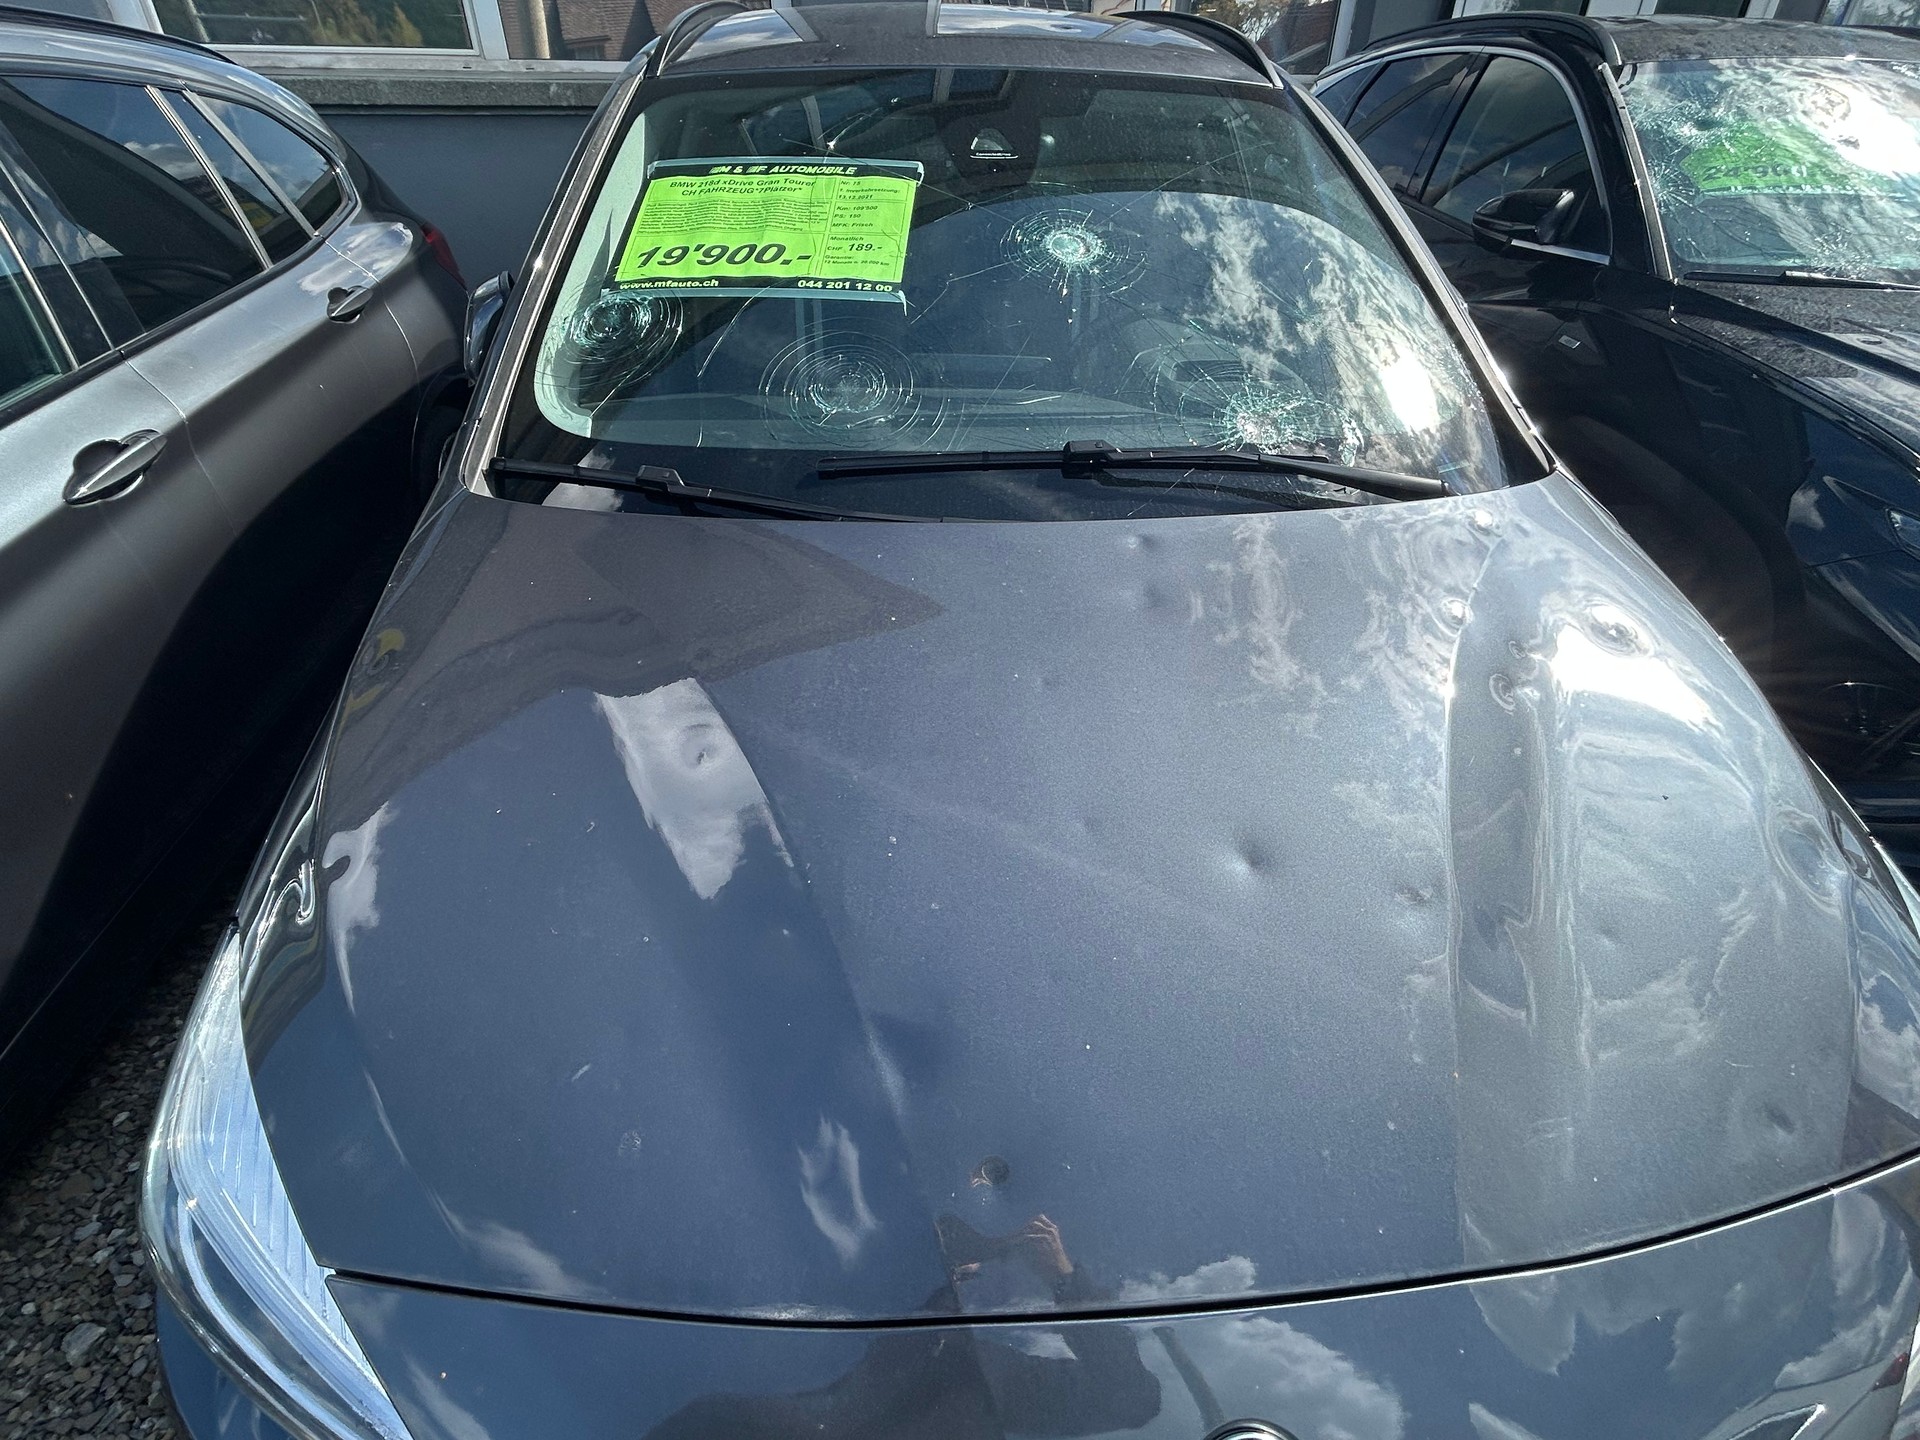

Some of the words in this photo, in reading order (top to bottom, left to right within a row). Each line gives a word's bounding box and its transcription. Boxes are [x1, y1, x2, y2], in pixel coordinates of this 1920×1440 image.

[733, 165, 743, 173] &
[768, 165, 857, 175] AUTOMOBILE
[699, 179, 720, 187] 218d
[722, 179, 754, 187] xDrive
[757, 179, 780, 187] Gran
[783, 177, 816, 187] Tourer
[848, 243, 883, 251] 189.-
[637, 243, 813, 269] 19'900.-
[619, 279, 719, 290] www.mfauto.ch
[797, 279, 823, 289] 044
[826, 281, 851, 290] 201
[855, 282, 872, 291] 12
[875, 283, 893, 292] 00
